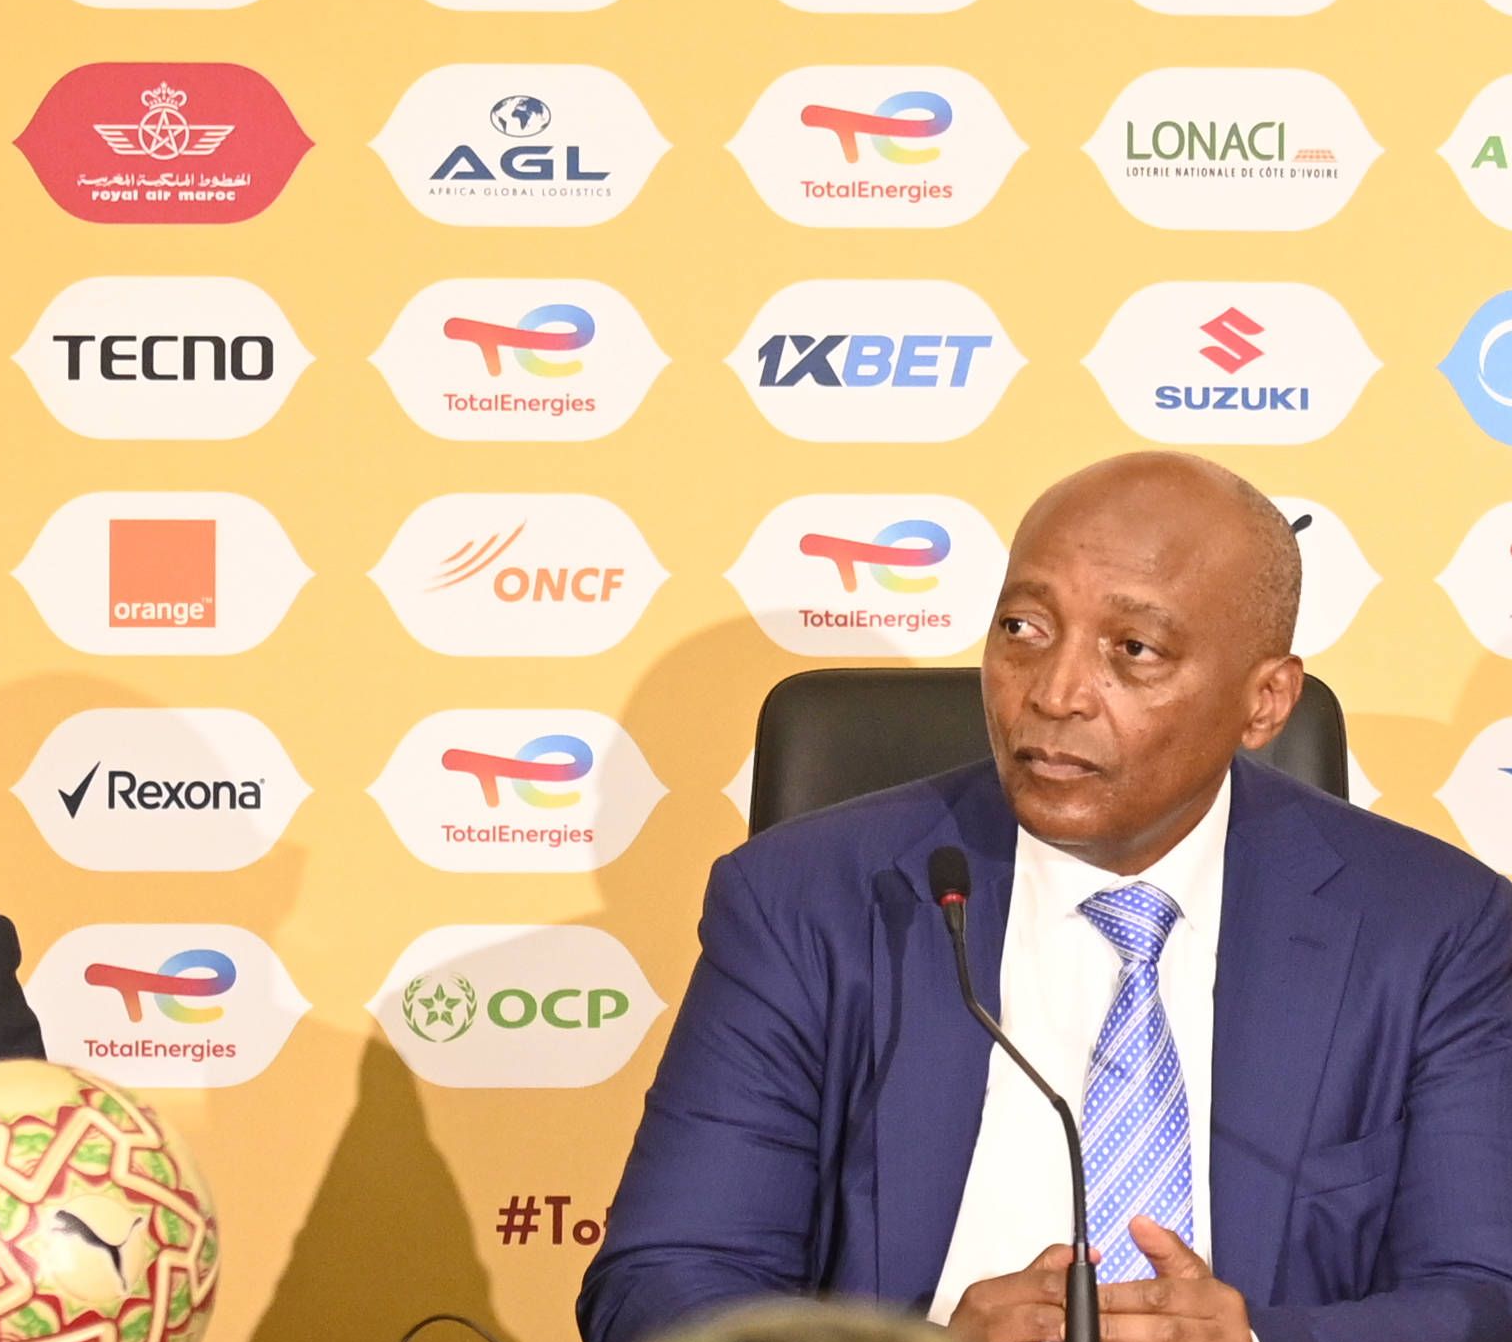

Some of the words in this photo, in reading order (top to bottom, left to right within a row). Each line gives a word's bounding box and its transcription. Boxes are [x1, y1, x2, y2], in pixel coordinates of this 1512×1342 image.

[1127, 121, 1284, 161] LONACI
[430, 145, 610, 180] AGL
[1126, 166, 1169, 178] LOTERIE
[1175, 166, 1235, 178] NATIONALE
[1240, 167, 1254, 179] DE
[91, 189, 139, 202] royal
[145, 189, 172, 201] air
[178, 190, 236, 201] maroc
[428, 187, 477, 199] AFRICA
[483, 187, 536, 200] GLOBAL
[541, 187, 613, 200] LOGISTICS
[53, 336, 273, 380] TECNO
[758, 335, 992, 387] 1XBET
[1156, 386, 1308, 410] SUZUKI
[494, 567, 624, 602] ONCF
[114, 597, 205, 622] orange
[798, 610, 950, 632] TotalEnergies
[109, 771, 260, 809] Rexona
[487, 989, 629, 1029] OCP
[84, 1039, 236, 1062] TotalEnergies
